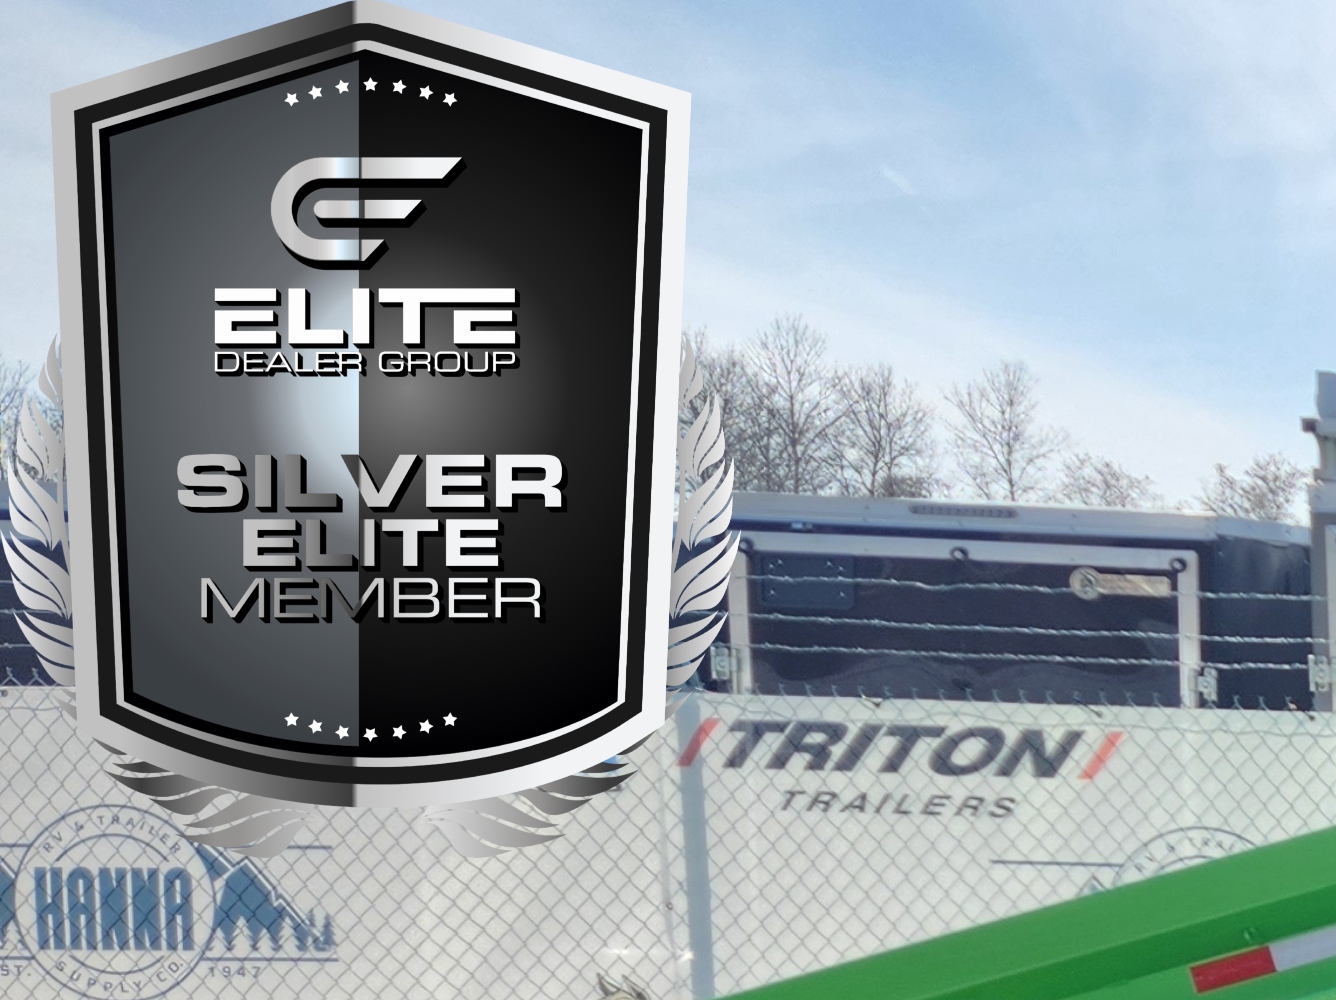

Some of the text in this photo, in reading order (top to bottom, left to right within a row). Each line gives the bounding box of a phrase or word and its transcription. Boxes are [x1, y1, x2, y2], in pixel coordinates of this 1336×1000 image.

[723, 718, 1086, 779] TRITON
[780, 789, 1018, 819] TRAILERS
[42, 814, 182, 854] RV & TRAILER
[33, 866, 195, 950] HANNA
[55, 960, 143, 993] SUPPLY
[208, 965, 262, 979] 1947
